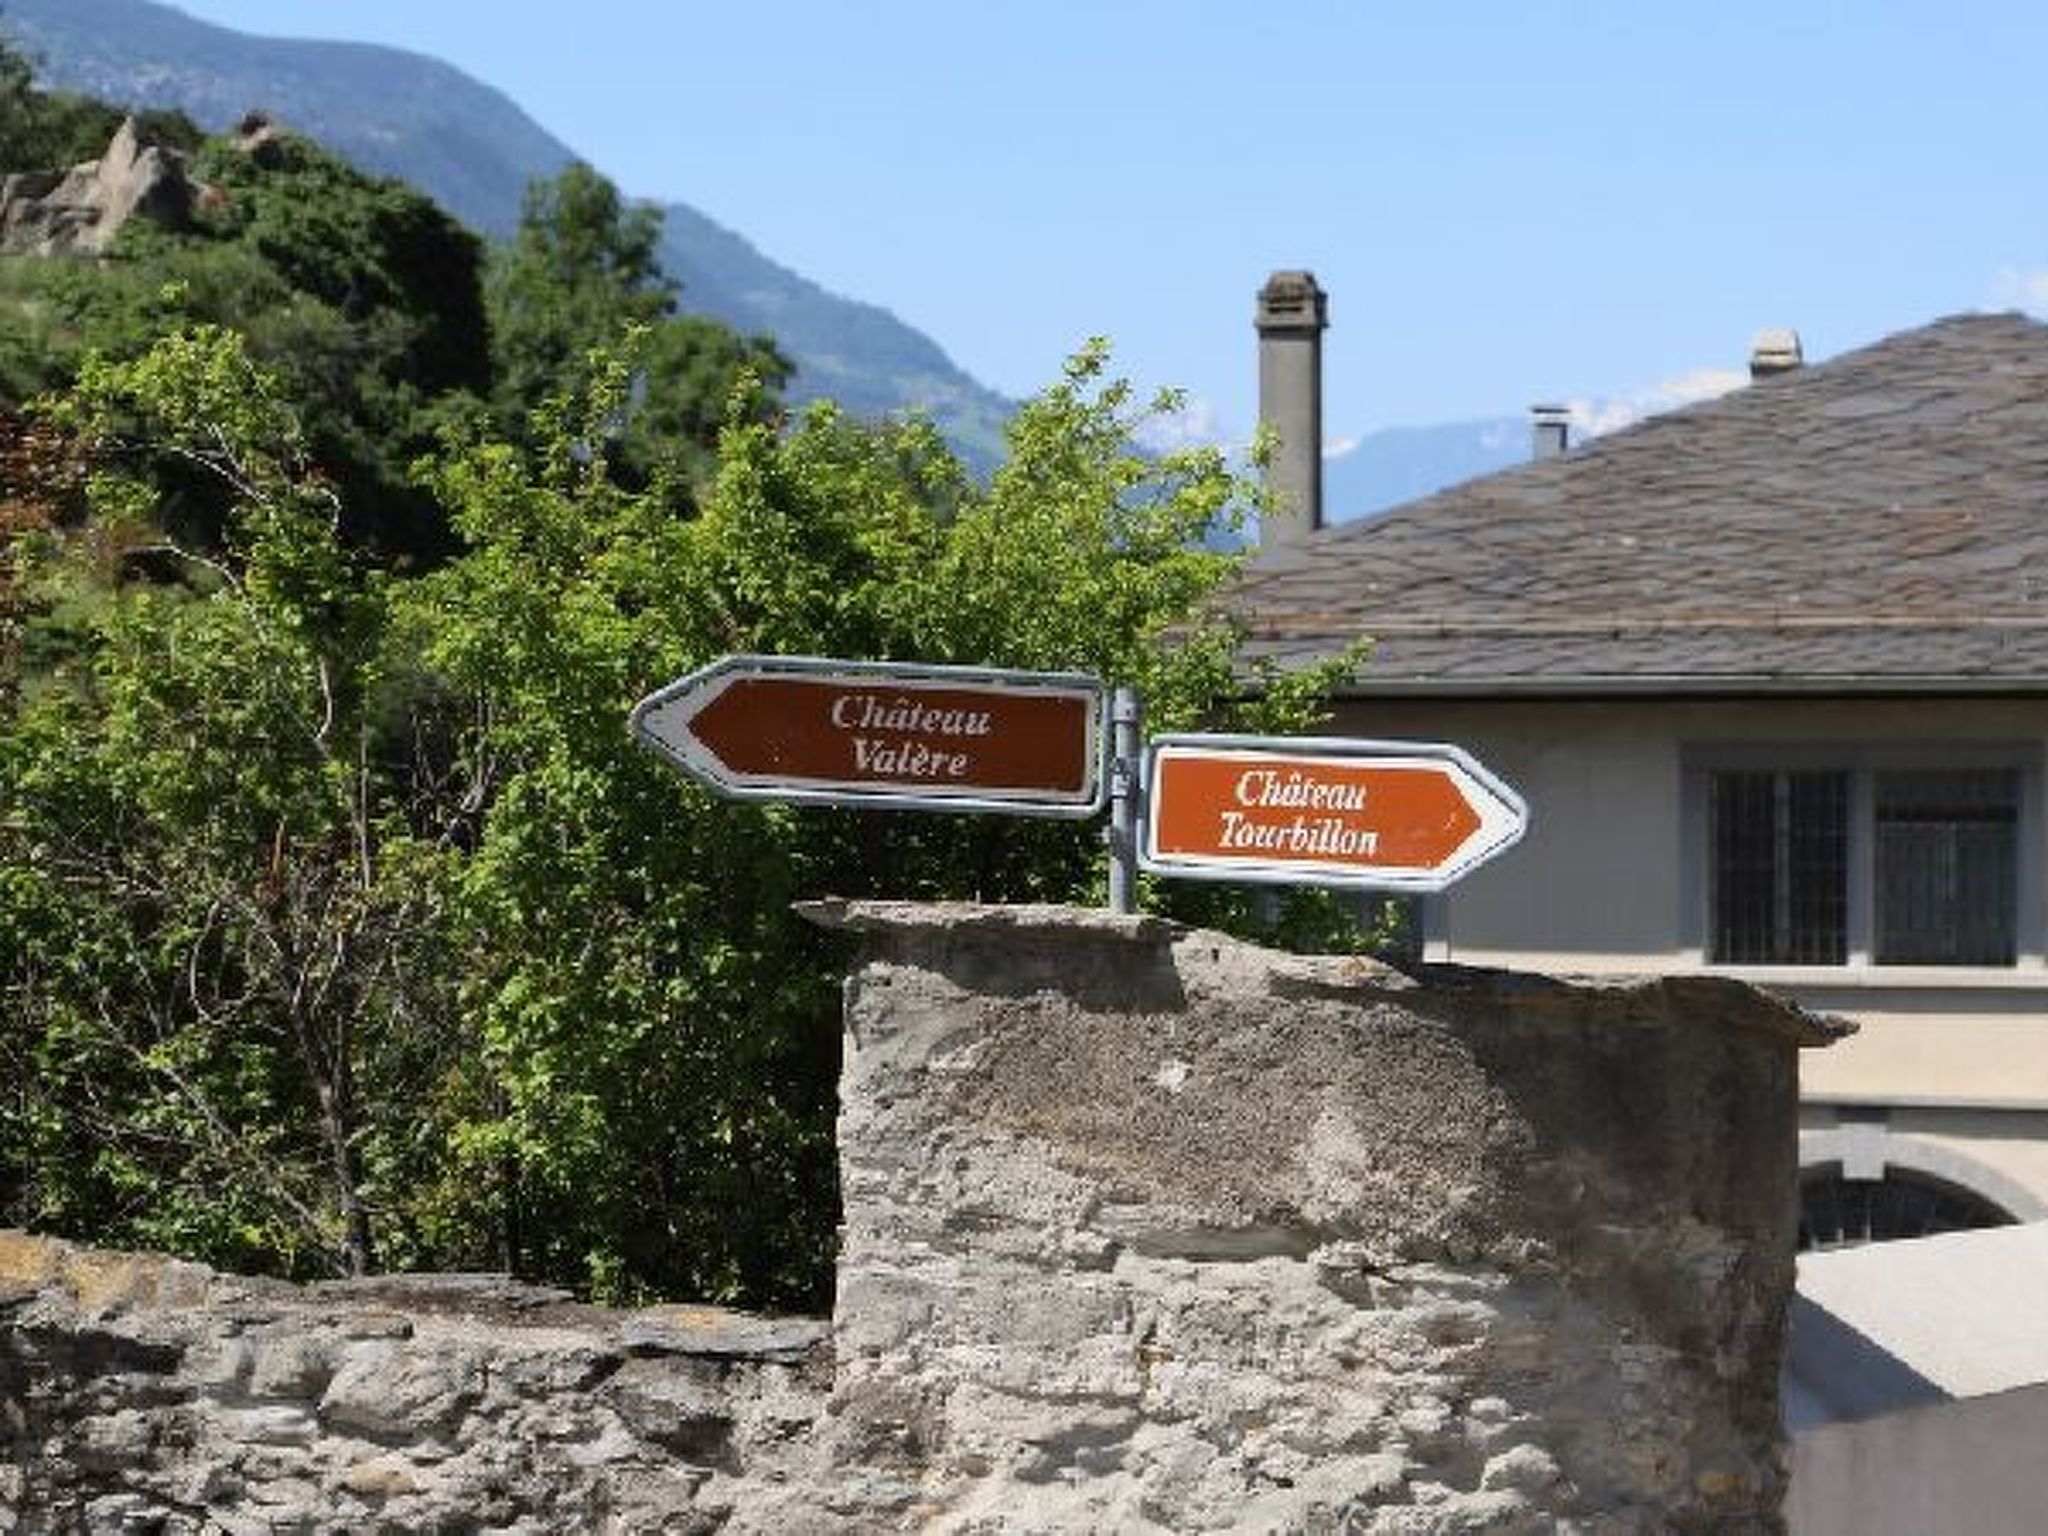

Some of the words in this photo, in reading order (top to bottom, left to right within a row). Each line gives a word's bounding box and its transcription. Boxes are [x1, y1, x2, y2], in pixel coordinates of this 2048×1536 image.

[830, 694, 991, 737] Château
[851, 737, 968, 778] Valère
[1235, 769, 1367, 811] Château
[1217, 811, 1379, 857] Tourbillon
